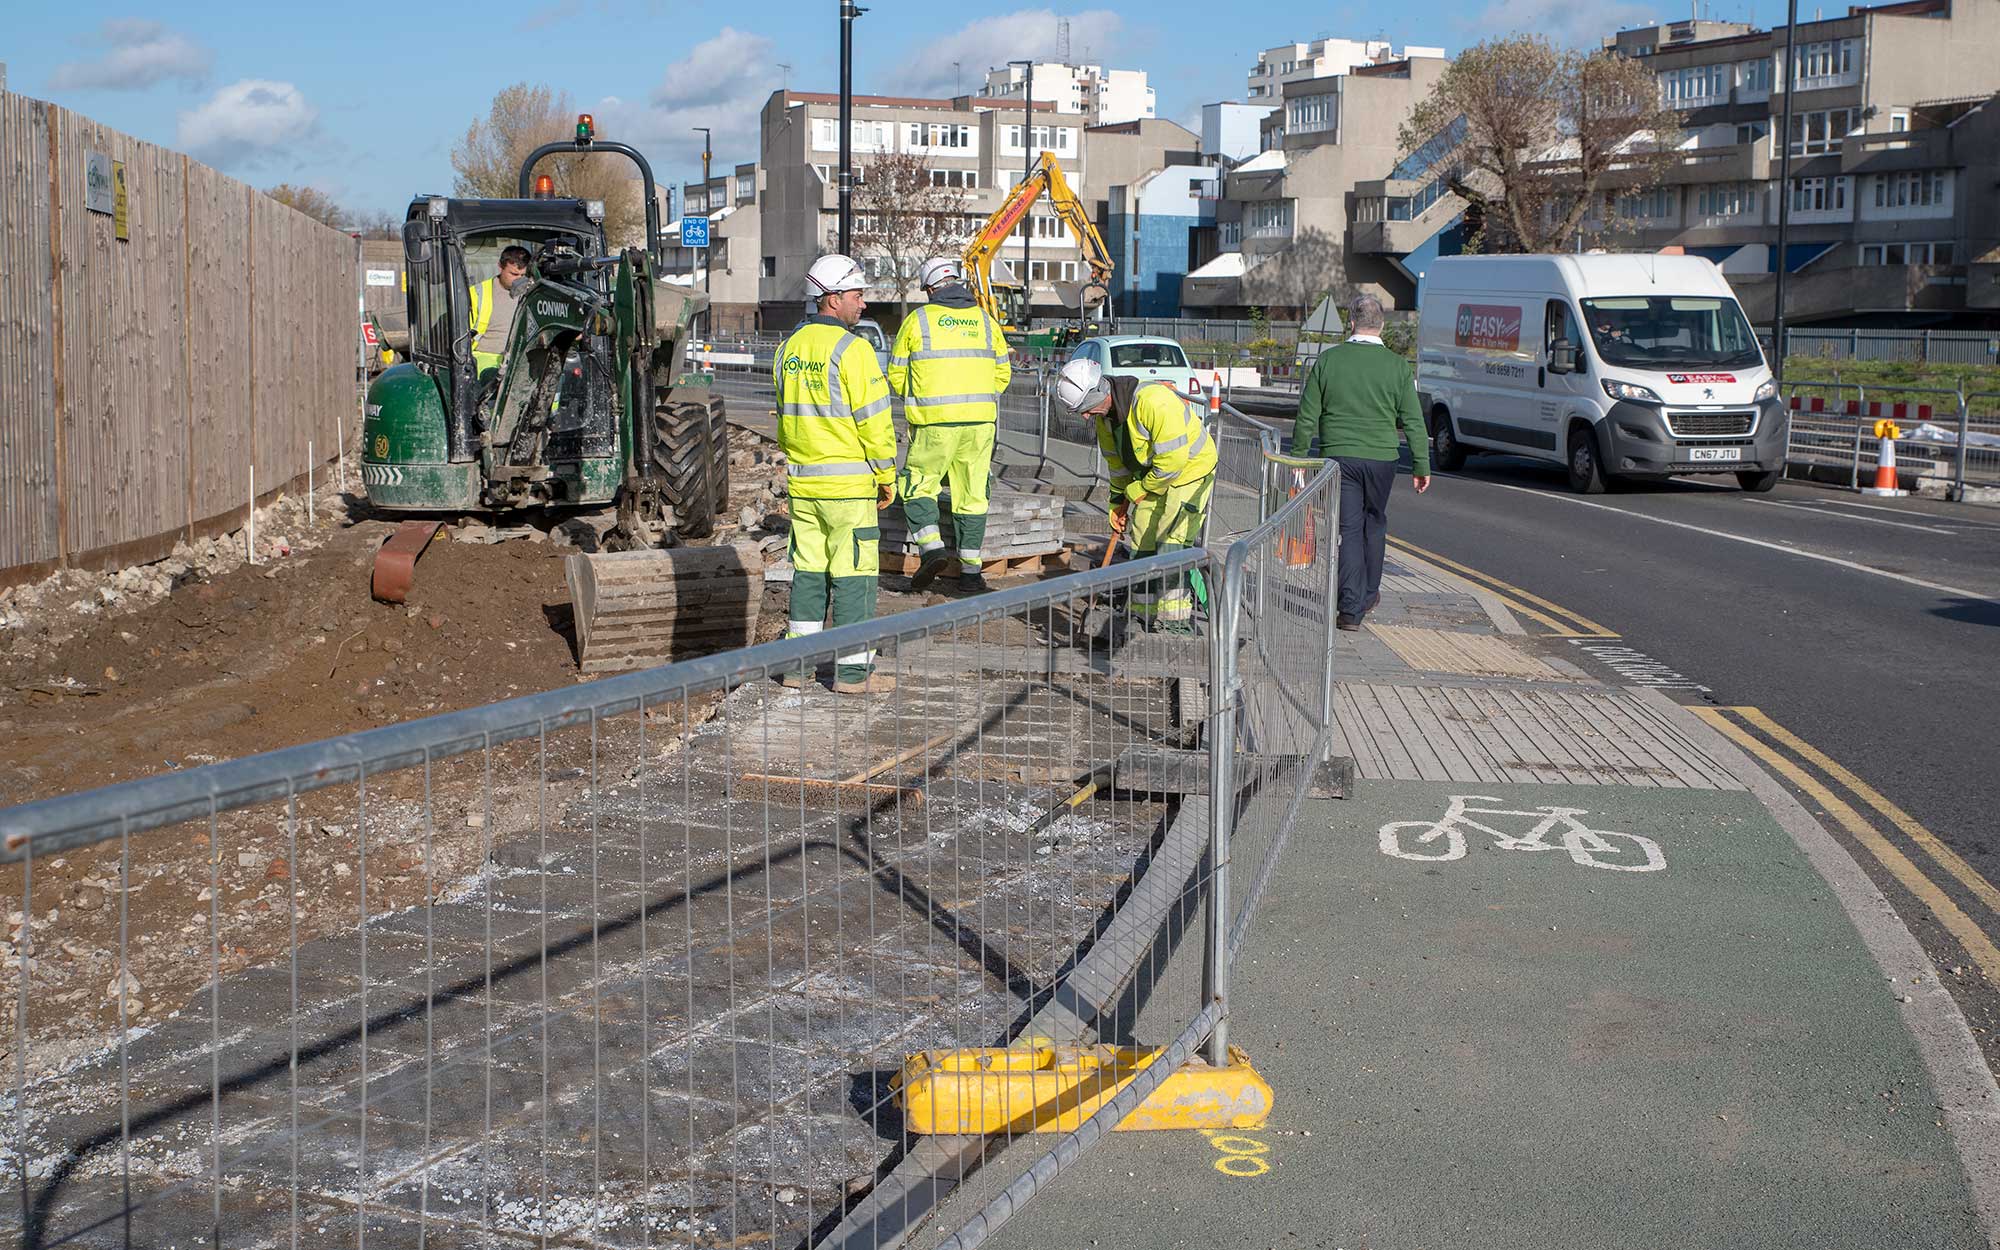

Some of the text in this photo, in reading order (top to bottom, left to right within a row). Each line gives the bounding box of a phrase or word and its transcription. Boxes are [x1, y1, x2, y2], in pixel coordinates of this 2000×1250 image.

[537, 300, 570, 319] CONWAY
[937, 316, 979, 327] CONWAY
[1458, 315, 1472, 337] GO!
[1473, 315, 1504, 338] EASY
[783, 356, 826, 372] CONWAY
[1694, 449, 1737, 460] CN67 JTU
